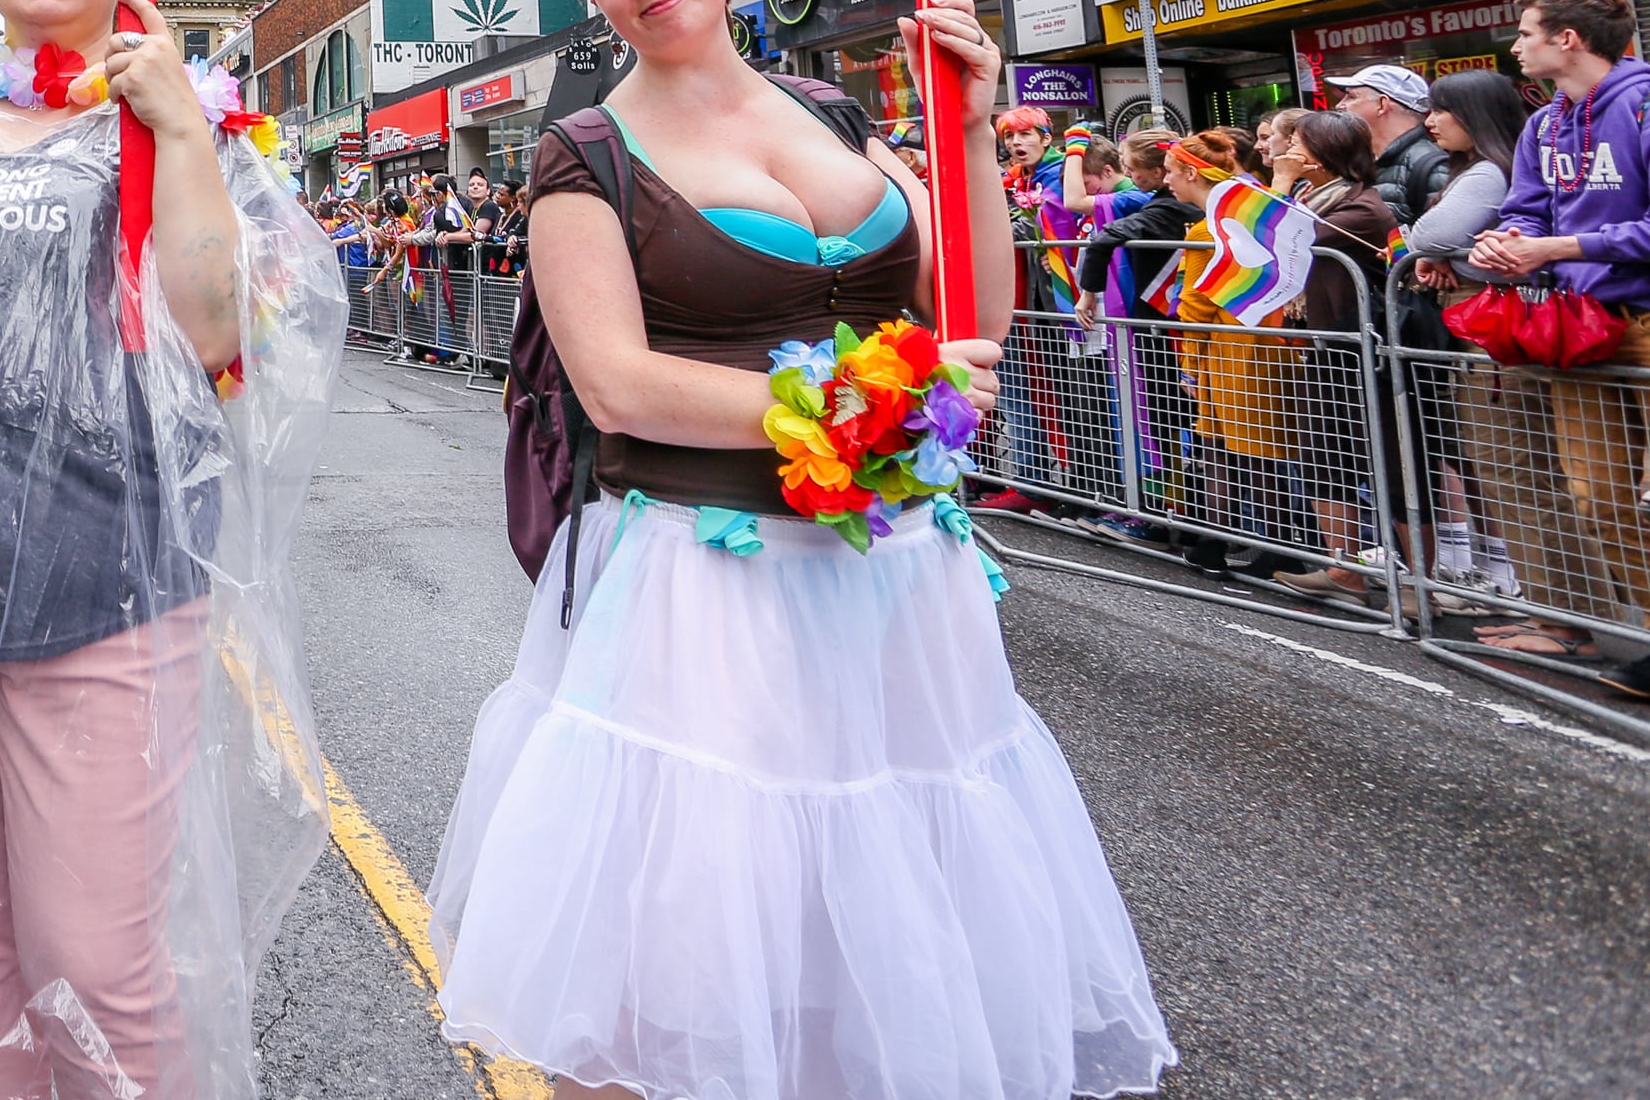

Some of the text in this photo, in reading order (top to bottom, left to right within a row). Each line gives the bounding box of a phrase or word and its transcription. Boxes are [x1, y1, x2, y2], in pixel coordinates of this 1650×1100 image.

[1123, 6, 1157, 33] Shp
[1315, 16, 1426, 50] Toronto's
[374, 42, 403, 64] THC
[573, 51, 592, 61] 659
[571, 62, 596, 70] Solis
[1024, 68, 1083, 89] LONGHAIRS
[1041, 82, 1066, 91] THE
[1022, 91, 1088, 101] NONSALON
